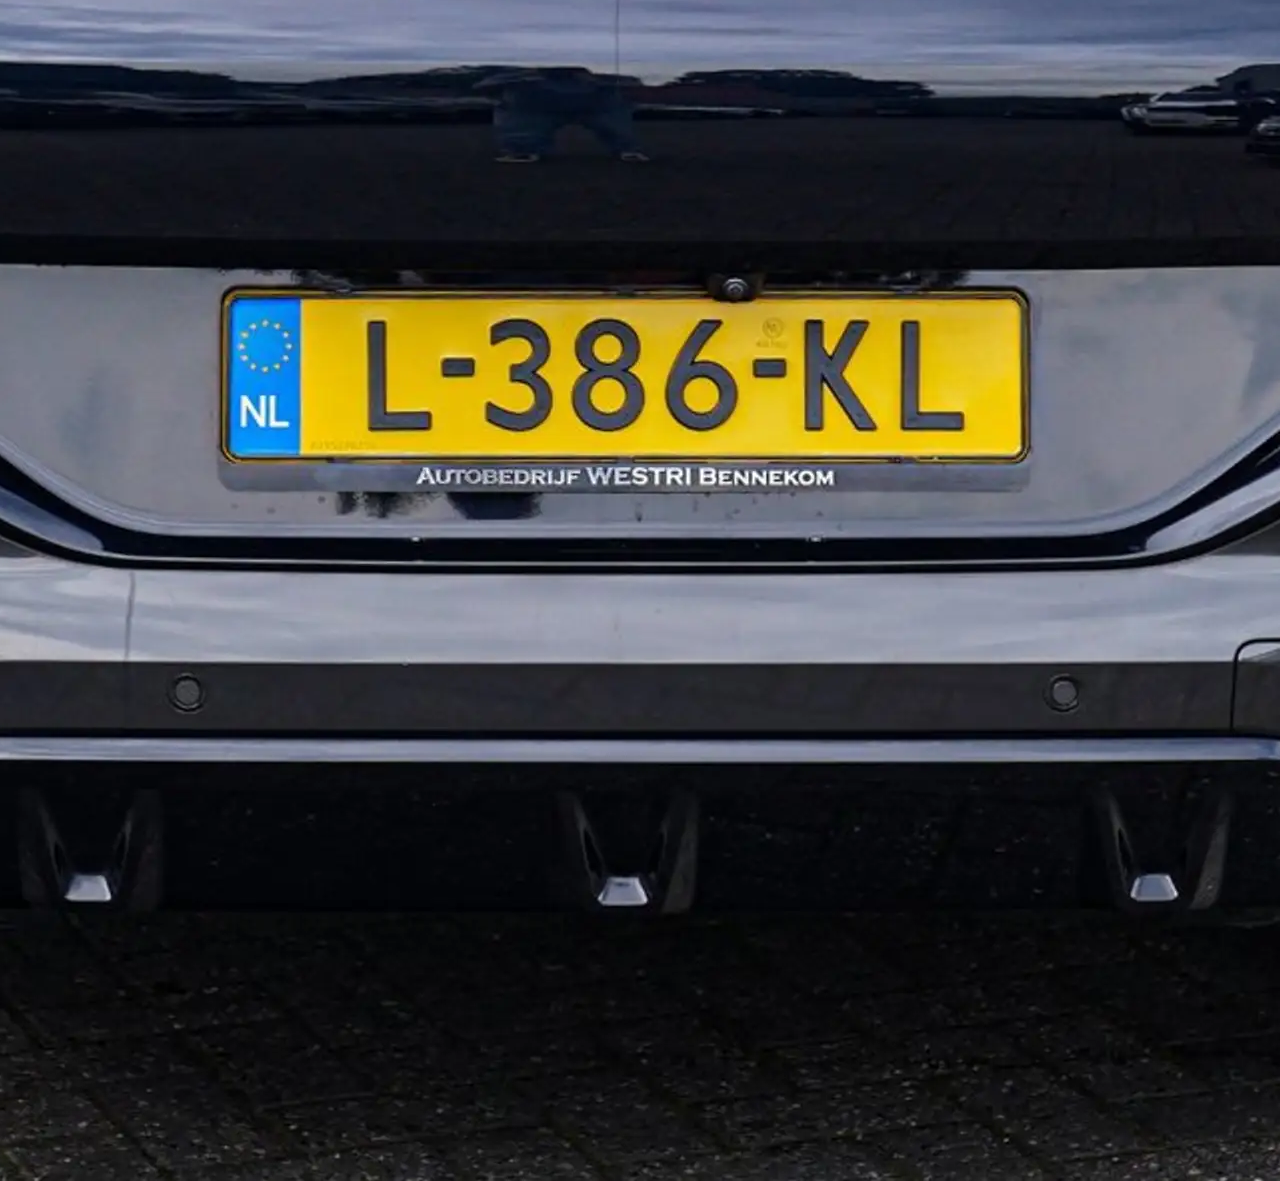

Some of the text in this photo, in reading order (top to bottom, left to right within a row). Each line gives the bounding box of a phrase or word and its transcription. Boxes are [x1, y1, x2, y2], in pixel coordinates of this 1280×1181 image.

[367, 318, 965, 432] L-386-KL
[239, 394, 290, 428] NL
[585, 466, 691, 486] WESTRI
